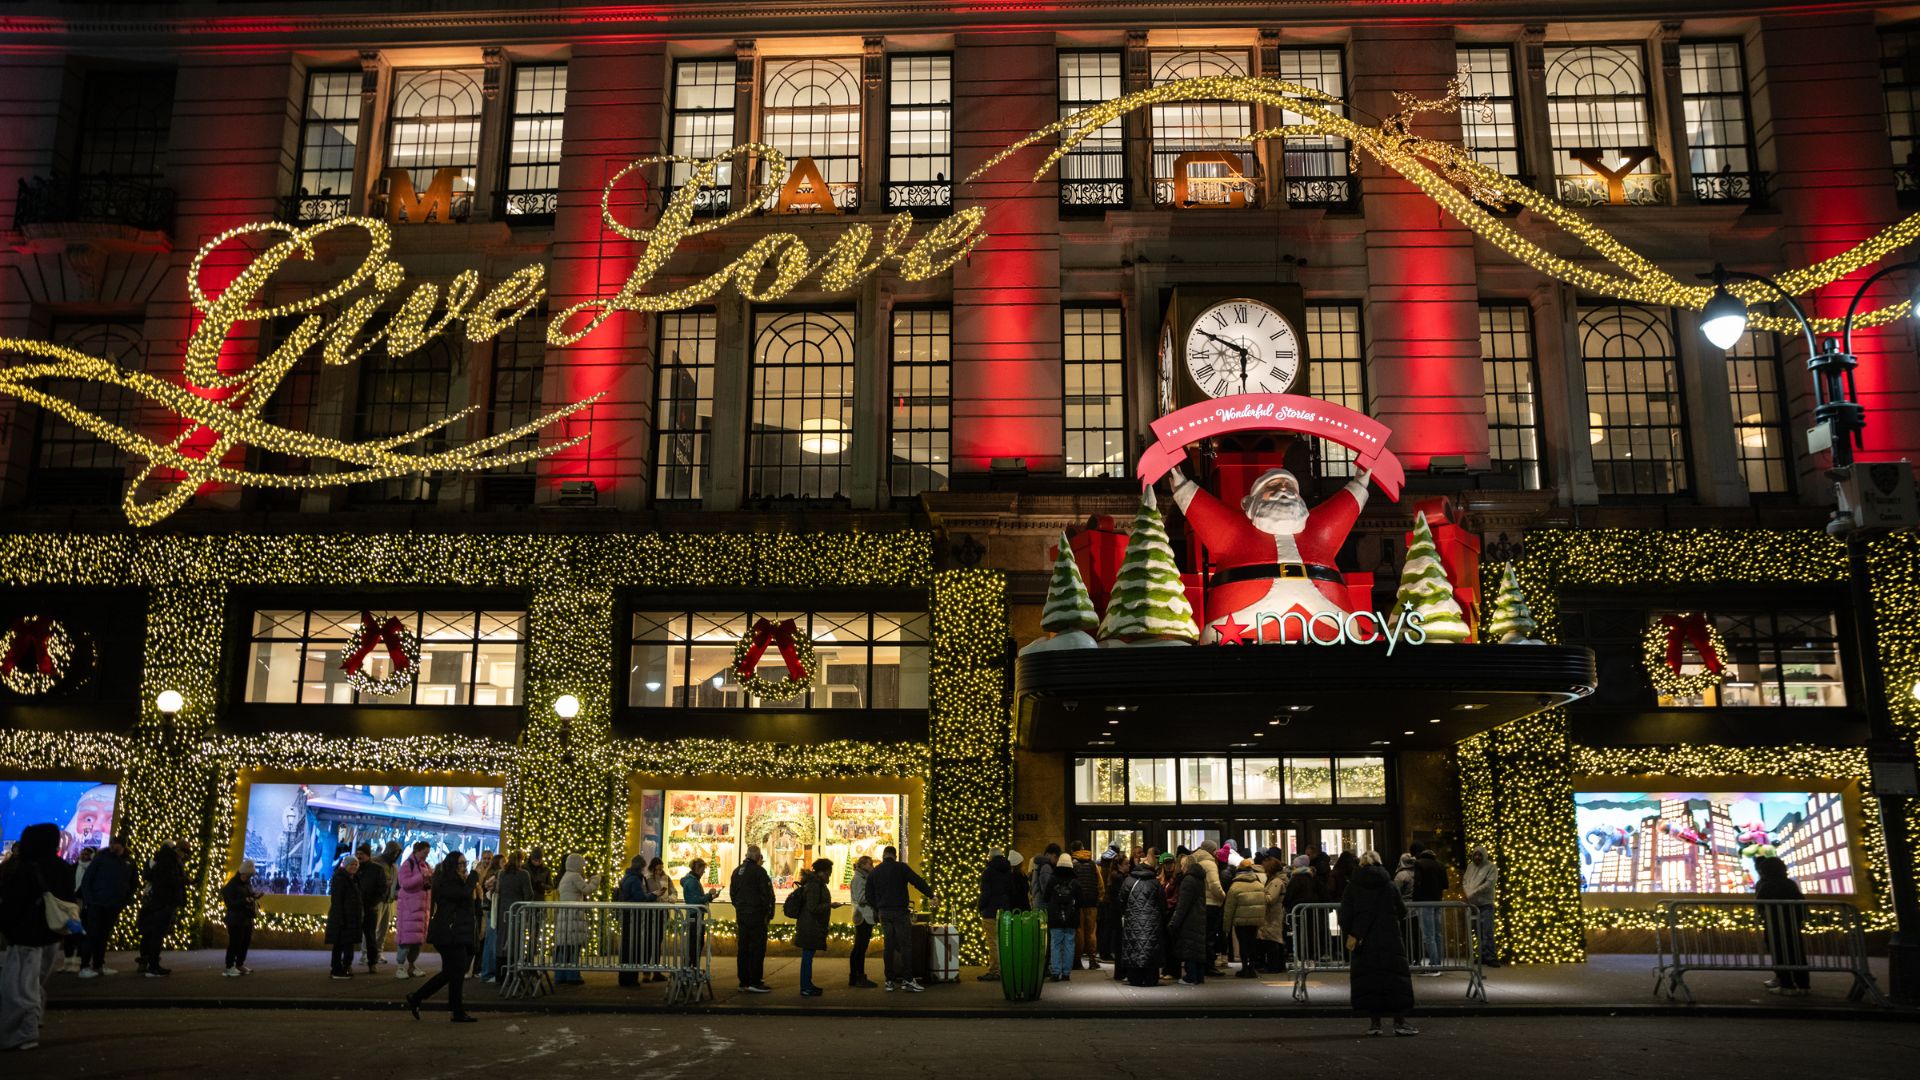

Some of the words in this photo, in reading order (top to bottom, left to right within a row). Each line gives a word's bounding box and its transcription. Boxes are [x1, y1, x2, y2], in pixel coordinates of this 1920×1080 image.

[383, 168, 462, 223] M
[771, 156, 837, 214] A
[1173, 151, 1246, 209] C
[1569, 147, 1654, 206] Y
[546, 142, 988, 346] Love
[1166, 426, 1184, 437] THE
[1188, 415, 1215, 428] MOST
[1215, 403, 1275, 422] Wonderful
[1275, 406, 1316, 421] Stories
[1318, 416, 1349, 430] START
[1353, 428, 1378, 443] HERE
[1256, 600, 1427, 656] macy's
